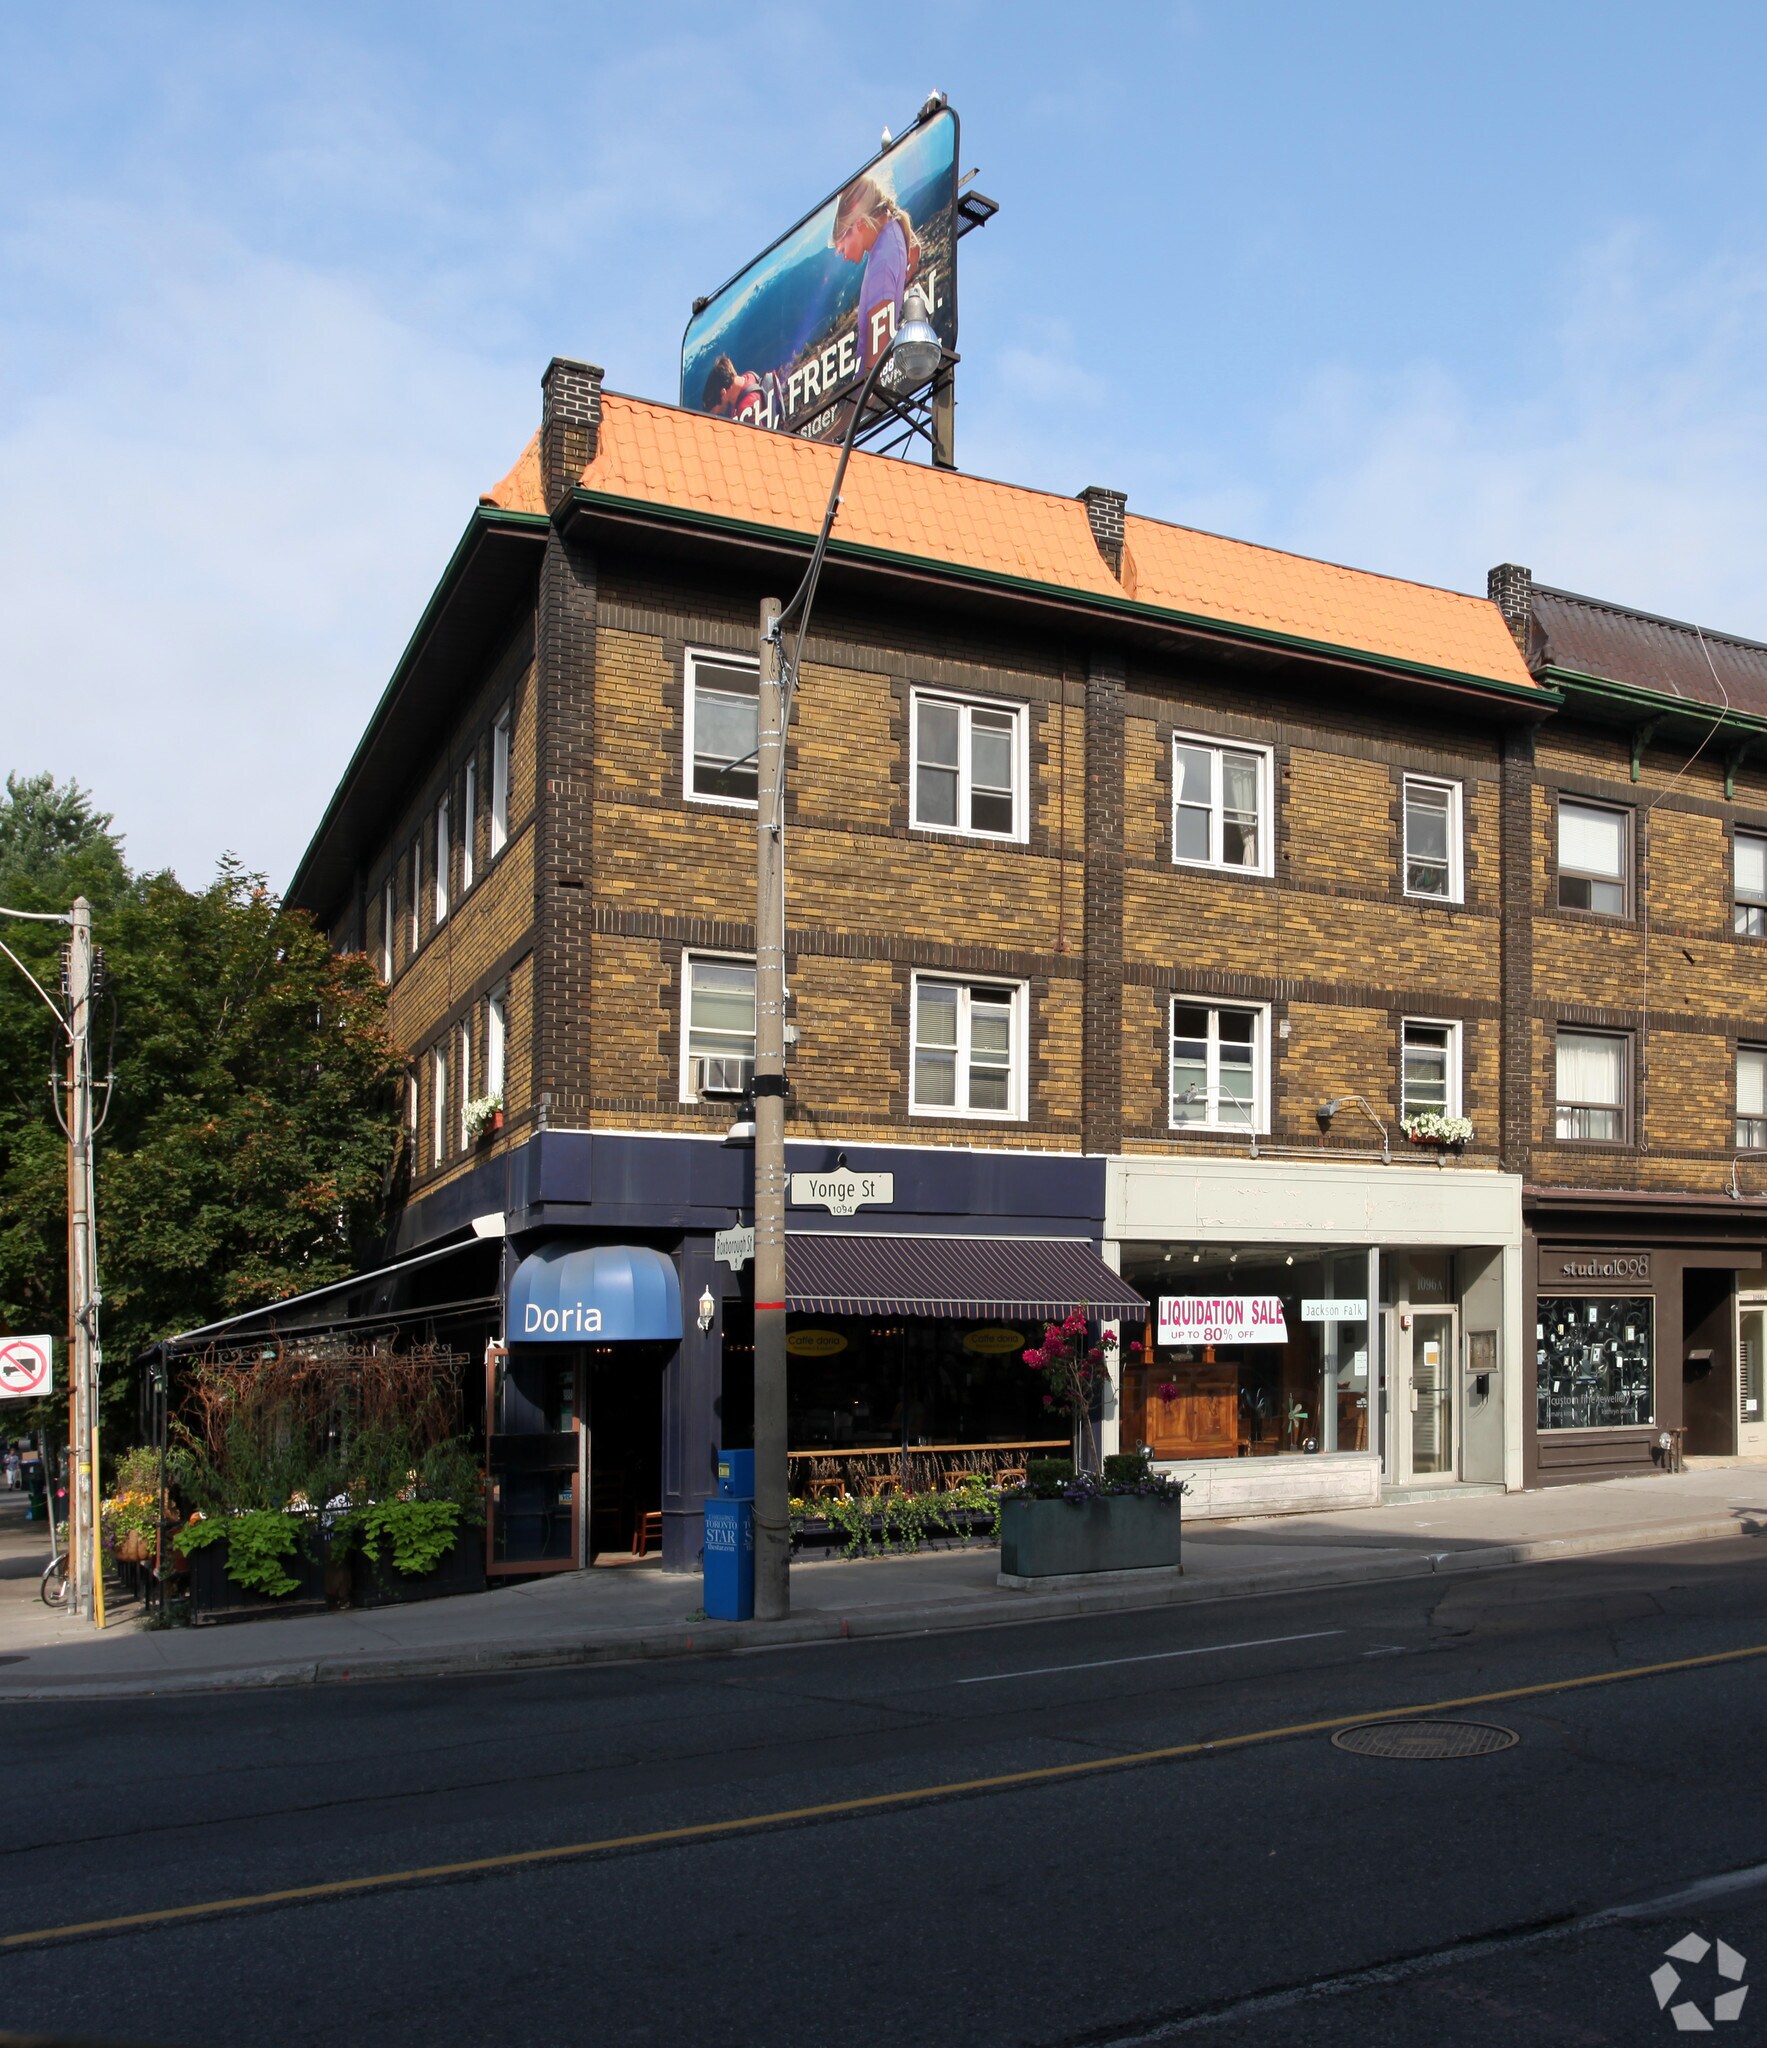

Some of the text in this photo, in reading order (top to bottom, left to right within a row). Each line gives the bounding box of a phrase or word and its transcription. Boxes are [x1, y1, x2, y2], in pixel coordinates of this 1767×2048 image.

[787, 331, 862, 415] FREE,
[810, 1179, 875, 1202] Yonge St
[832, 1204, 853, 1214] 1094
[1563, 1254, 1649, 1280] studio1098
[524, 1302, 602, 1333] Doria
[1160, 1299, 1284, 1327] LIQUIDATION SALE
[1305, 1303, 1363, 1317] Jackson Falk
[1170, 1327, 1255, 1342] UP TO 80% OFF
[1551, 1395, 1579, 1406] custom
[705, 1520, 738, 1530] TORONTO
[706, 1529, 736, 1544] STAR
